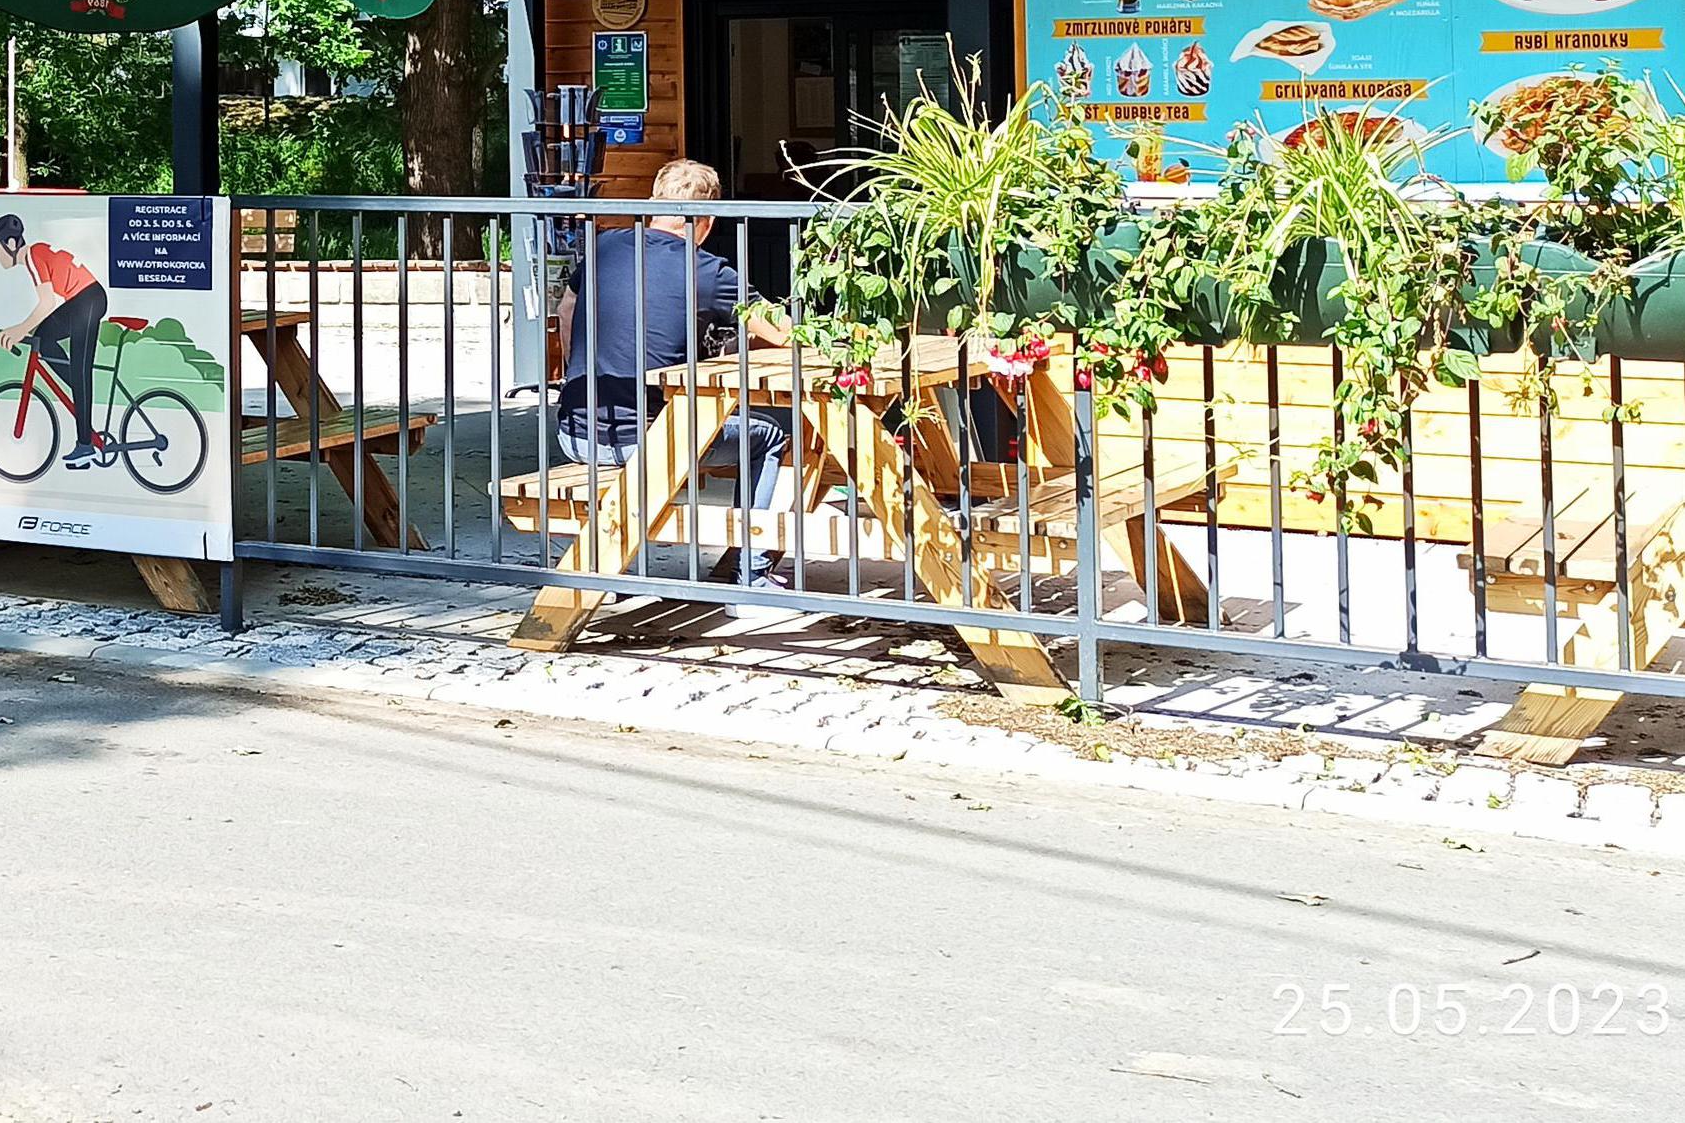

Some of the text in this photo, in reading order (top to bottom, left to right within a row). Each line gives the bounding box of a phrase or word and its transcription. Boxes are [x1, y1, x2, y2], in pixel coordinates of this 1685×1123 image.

[135, 205, 188, 214] REGISTRACE
[128, 219, 194, 228] OD 3. 5. DO 5. 6.
[130, 231, 151, 241] VÍCE
[152, 232, 201, 242] INFORMACÍ
[154, 247, 168, 255] NA
[117, 260, 206, 270] WWW.OTROKOVICKA
[138, 274, 187, 284] BESEDA.CZ
[40, 521, 93, 535] FORCE
